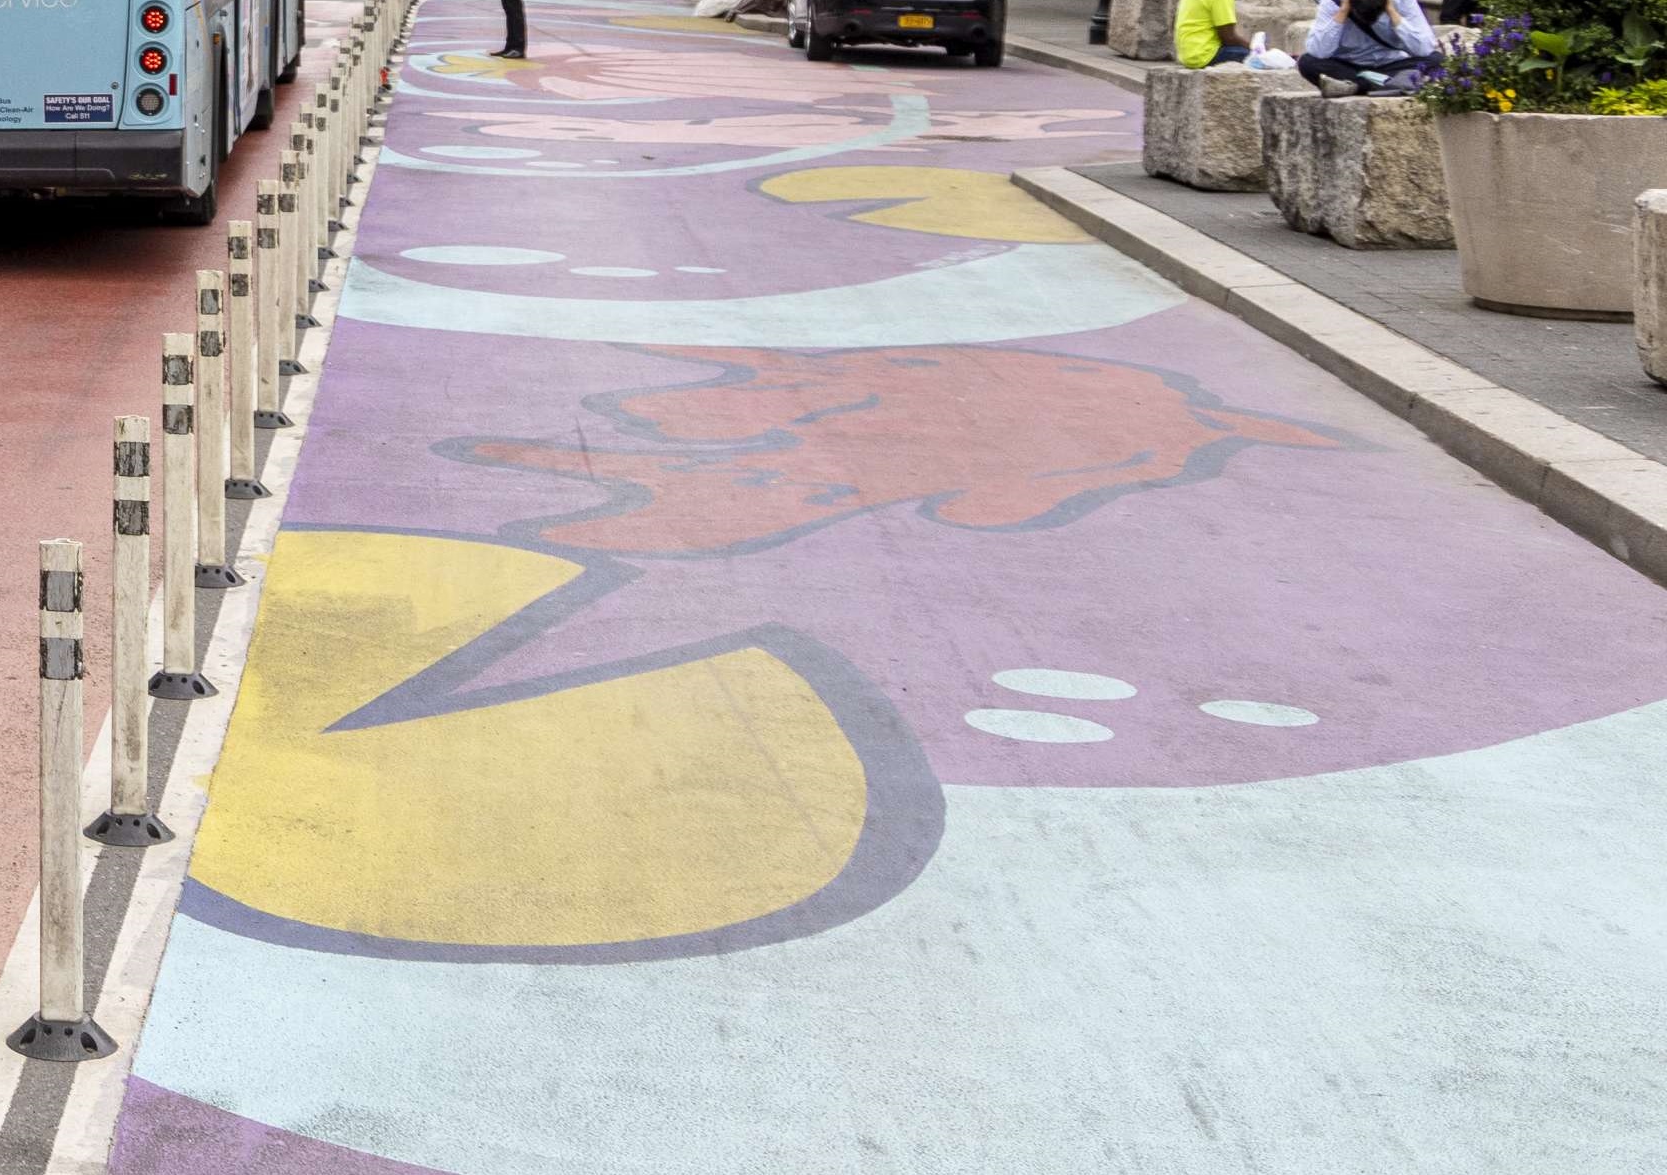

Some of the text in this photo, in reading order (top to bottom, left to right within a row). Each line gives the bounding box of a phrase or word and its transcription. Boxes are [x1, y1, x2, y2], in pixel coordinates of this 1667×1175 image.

[46, 96, 77, 104] SAFETY'S
[78, 96, 92, 104] OUR
[0, 106, 34, 114] Clean-Air
[87, 104, 111, 113] Doing?
[65, 112, 79, 120] Call
